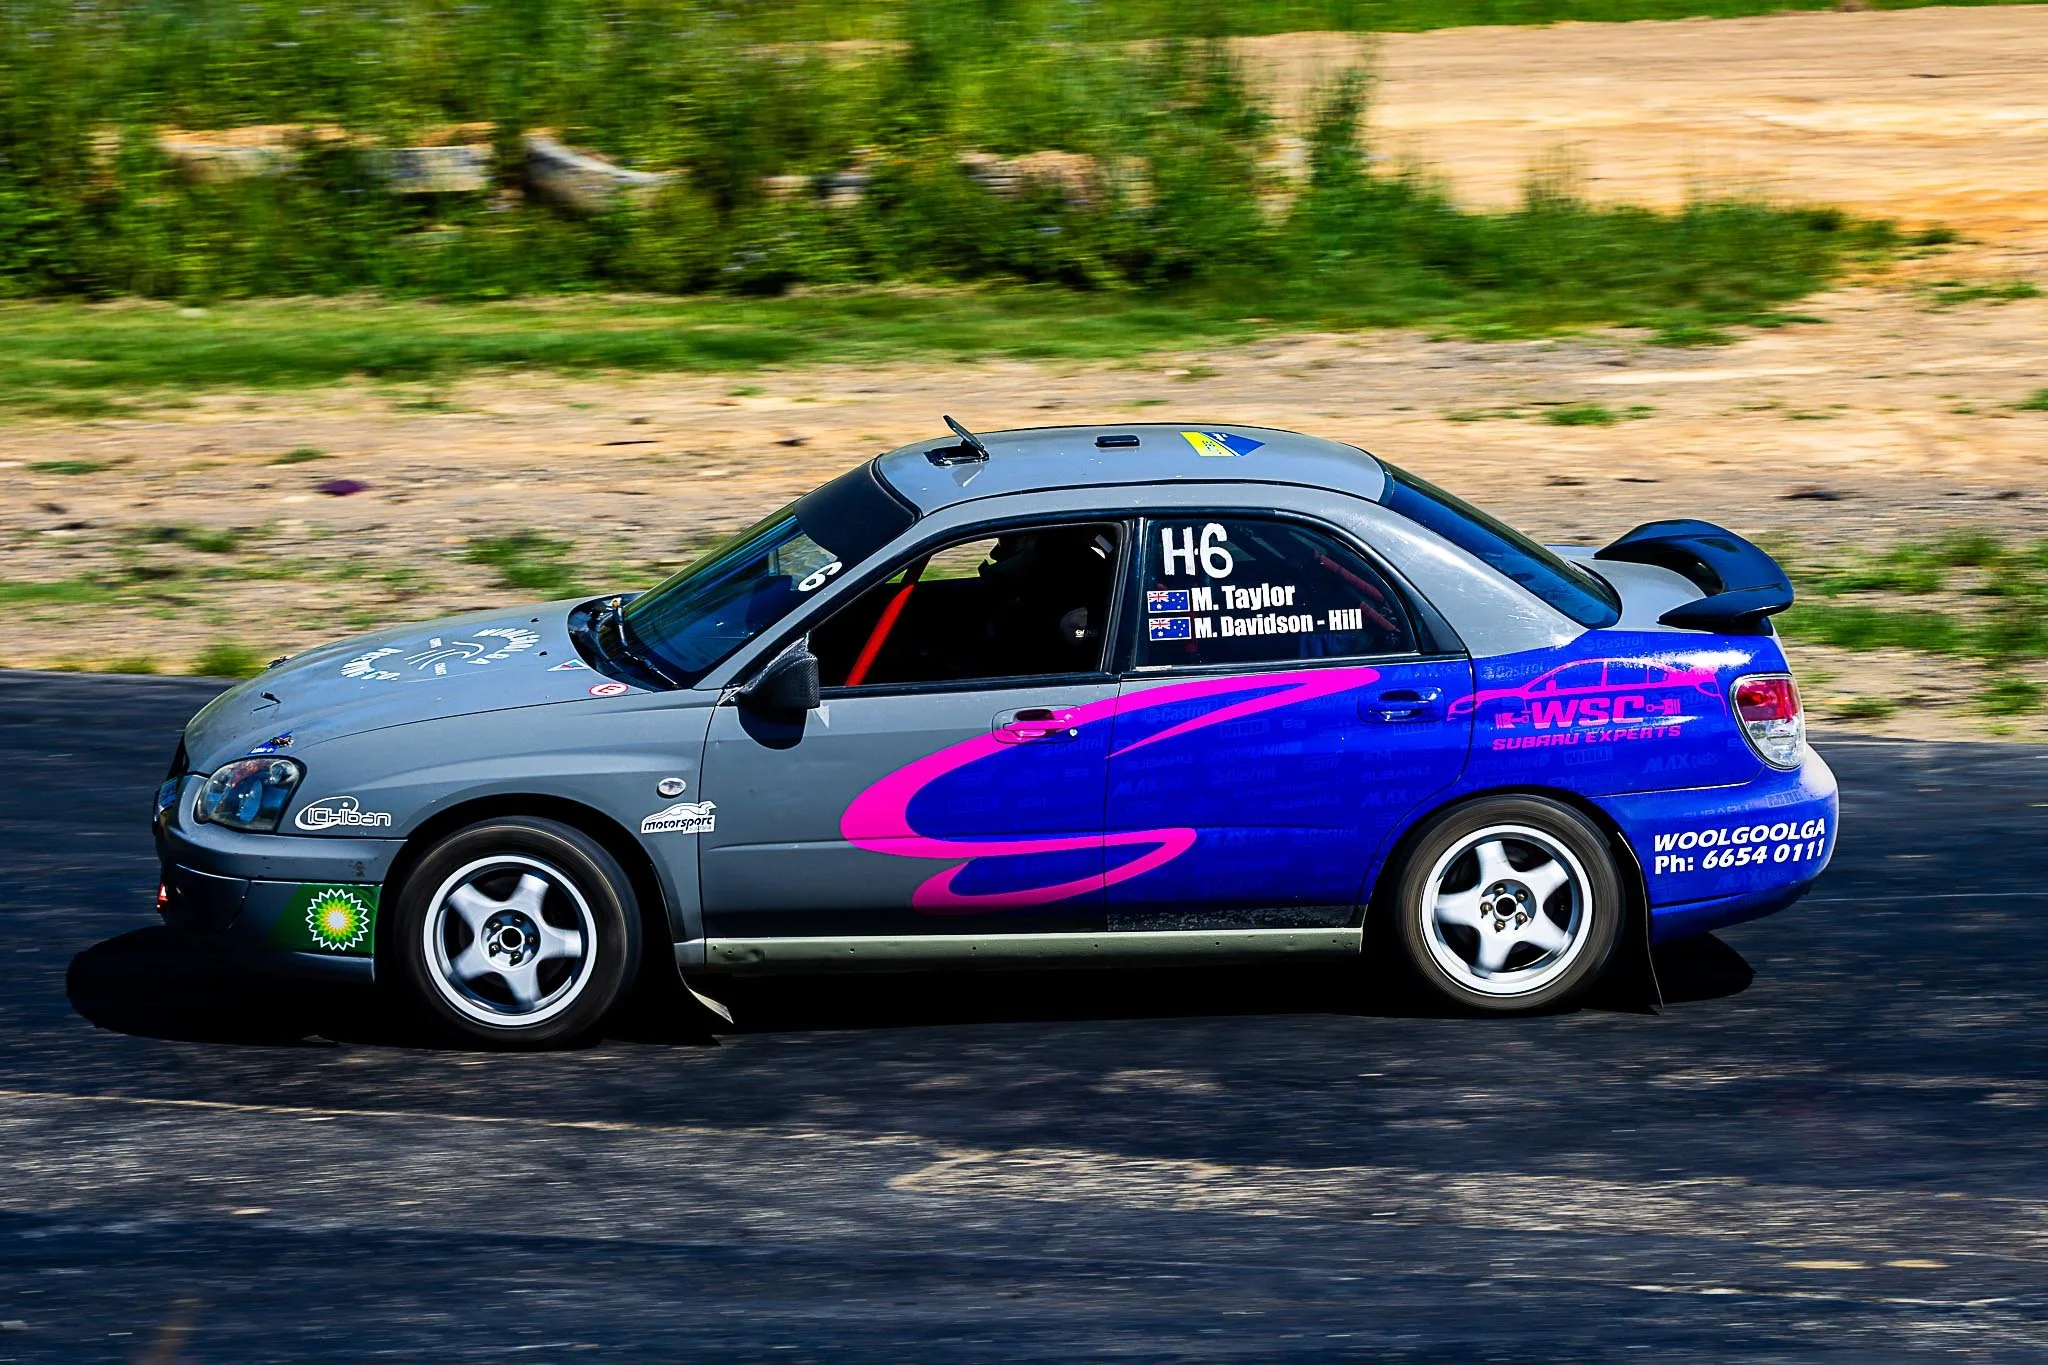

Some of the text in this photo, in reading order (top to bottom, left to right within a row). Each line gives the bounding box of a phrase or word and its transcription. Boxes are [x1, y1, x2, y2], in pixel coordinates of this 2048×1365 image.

[1161, 523, 1233, 578] H6
[798, 561, 842, 592] 6
[1191, 583, 1296, 612] M. Taylor
[1194, 617, 1217, 638] M.
[1220, 613, 1313, 638] Davidson
[1328, 608, 1363, 631] Hill
[1531, 696, 1645, 730] WSC
[1492, 725, 1681, 751] SUBARU EXPERTS
[643, 816, 713, 832] motorsport
[1654, 817, 1826, 852] WOOLGOOLGA
[1655, 837, 1826, 875] Ph: 6654 0111
